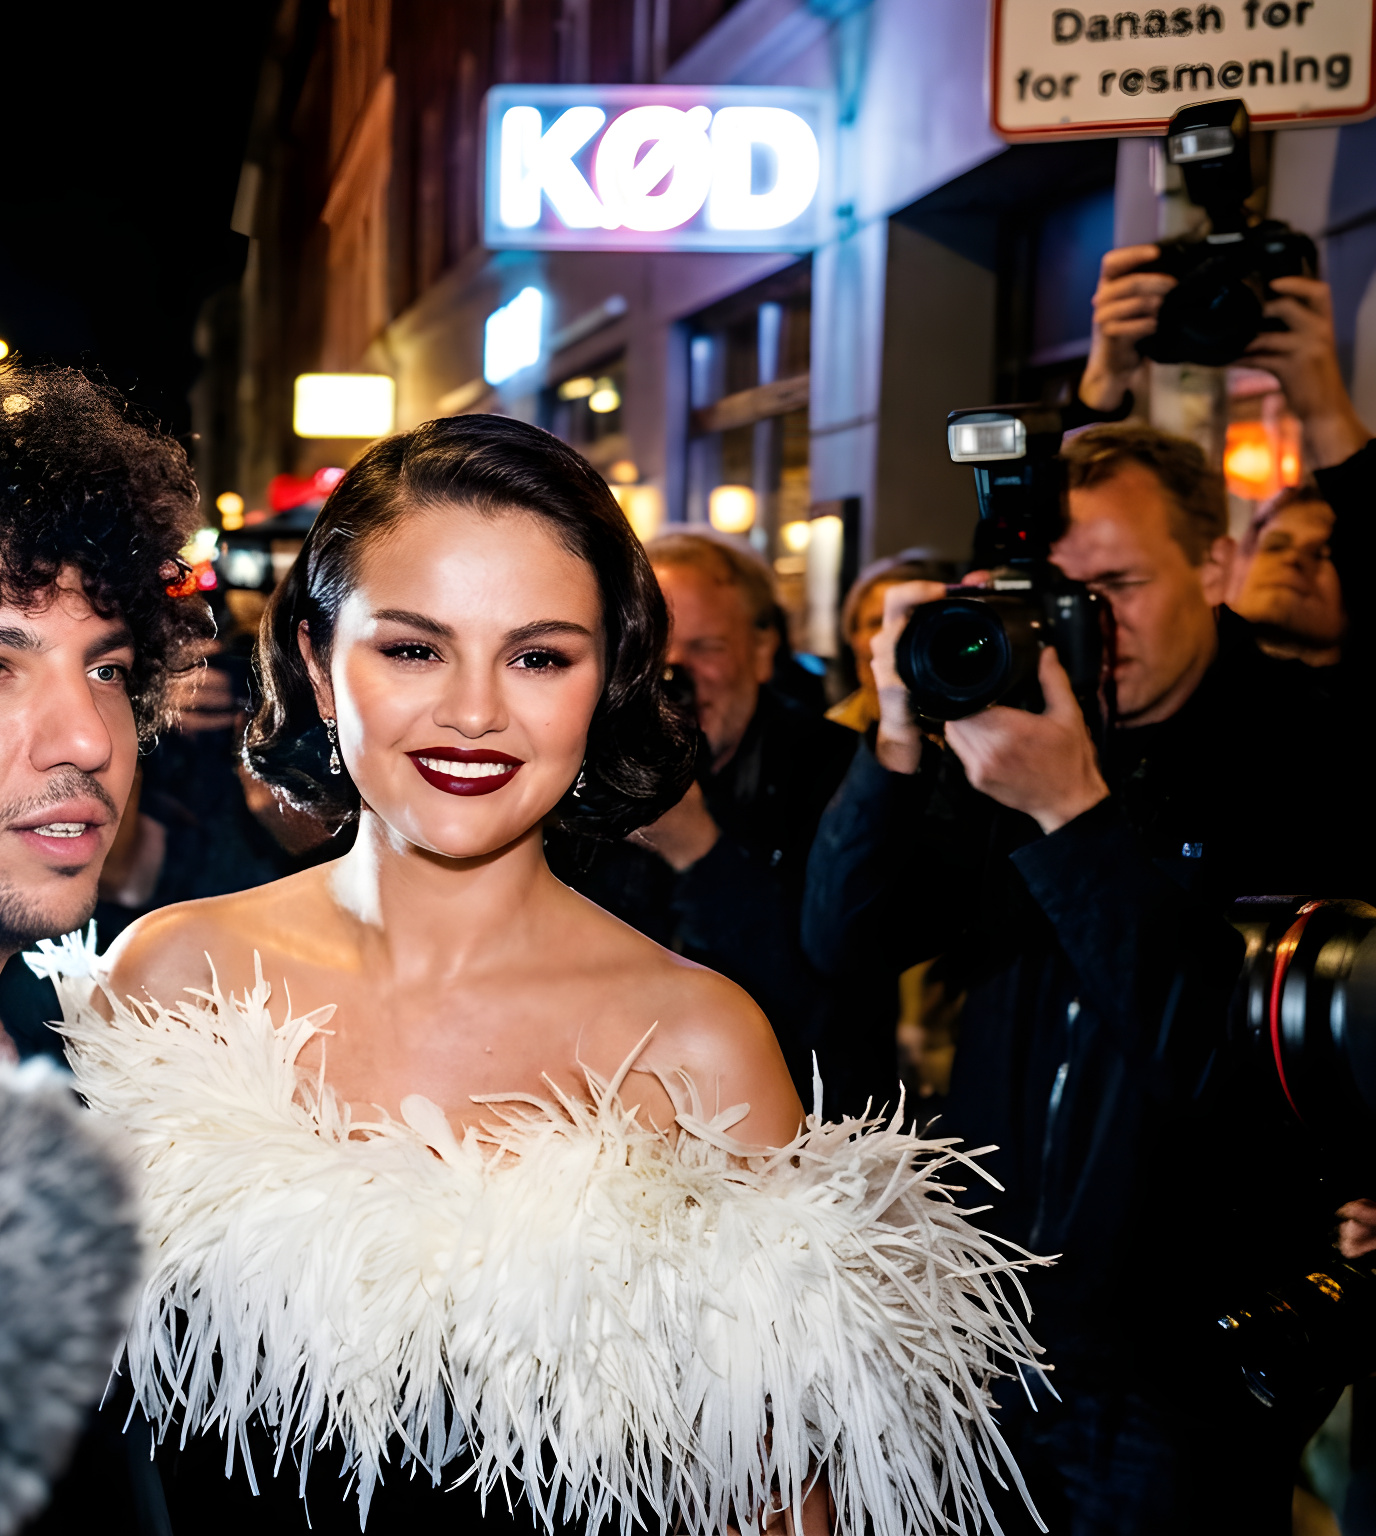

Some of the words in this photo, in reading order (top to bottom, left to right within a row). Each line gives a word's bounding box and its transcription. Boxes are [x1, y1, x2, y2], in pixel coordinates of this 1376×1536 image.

[1242, 0, 1314, 30] for
[1014, 67, 1080, 103] for
[499, 104, 821, 232] KØD
